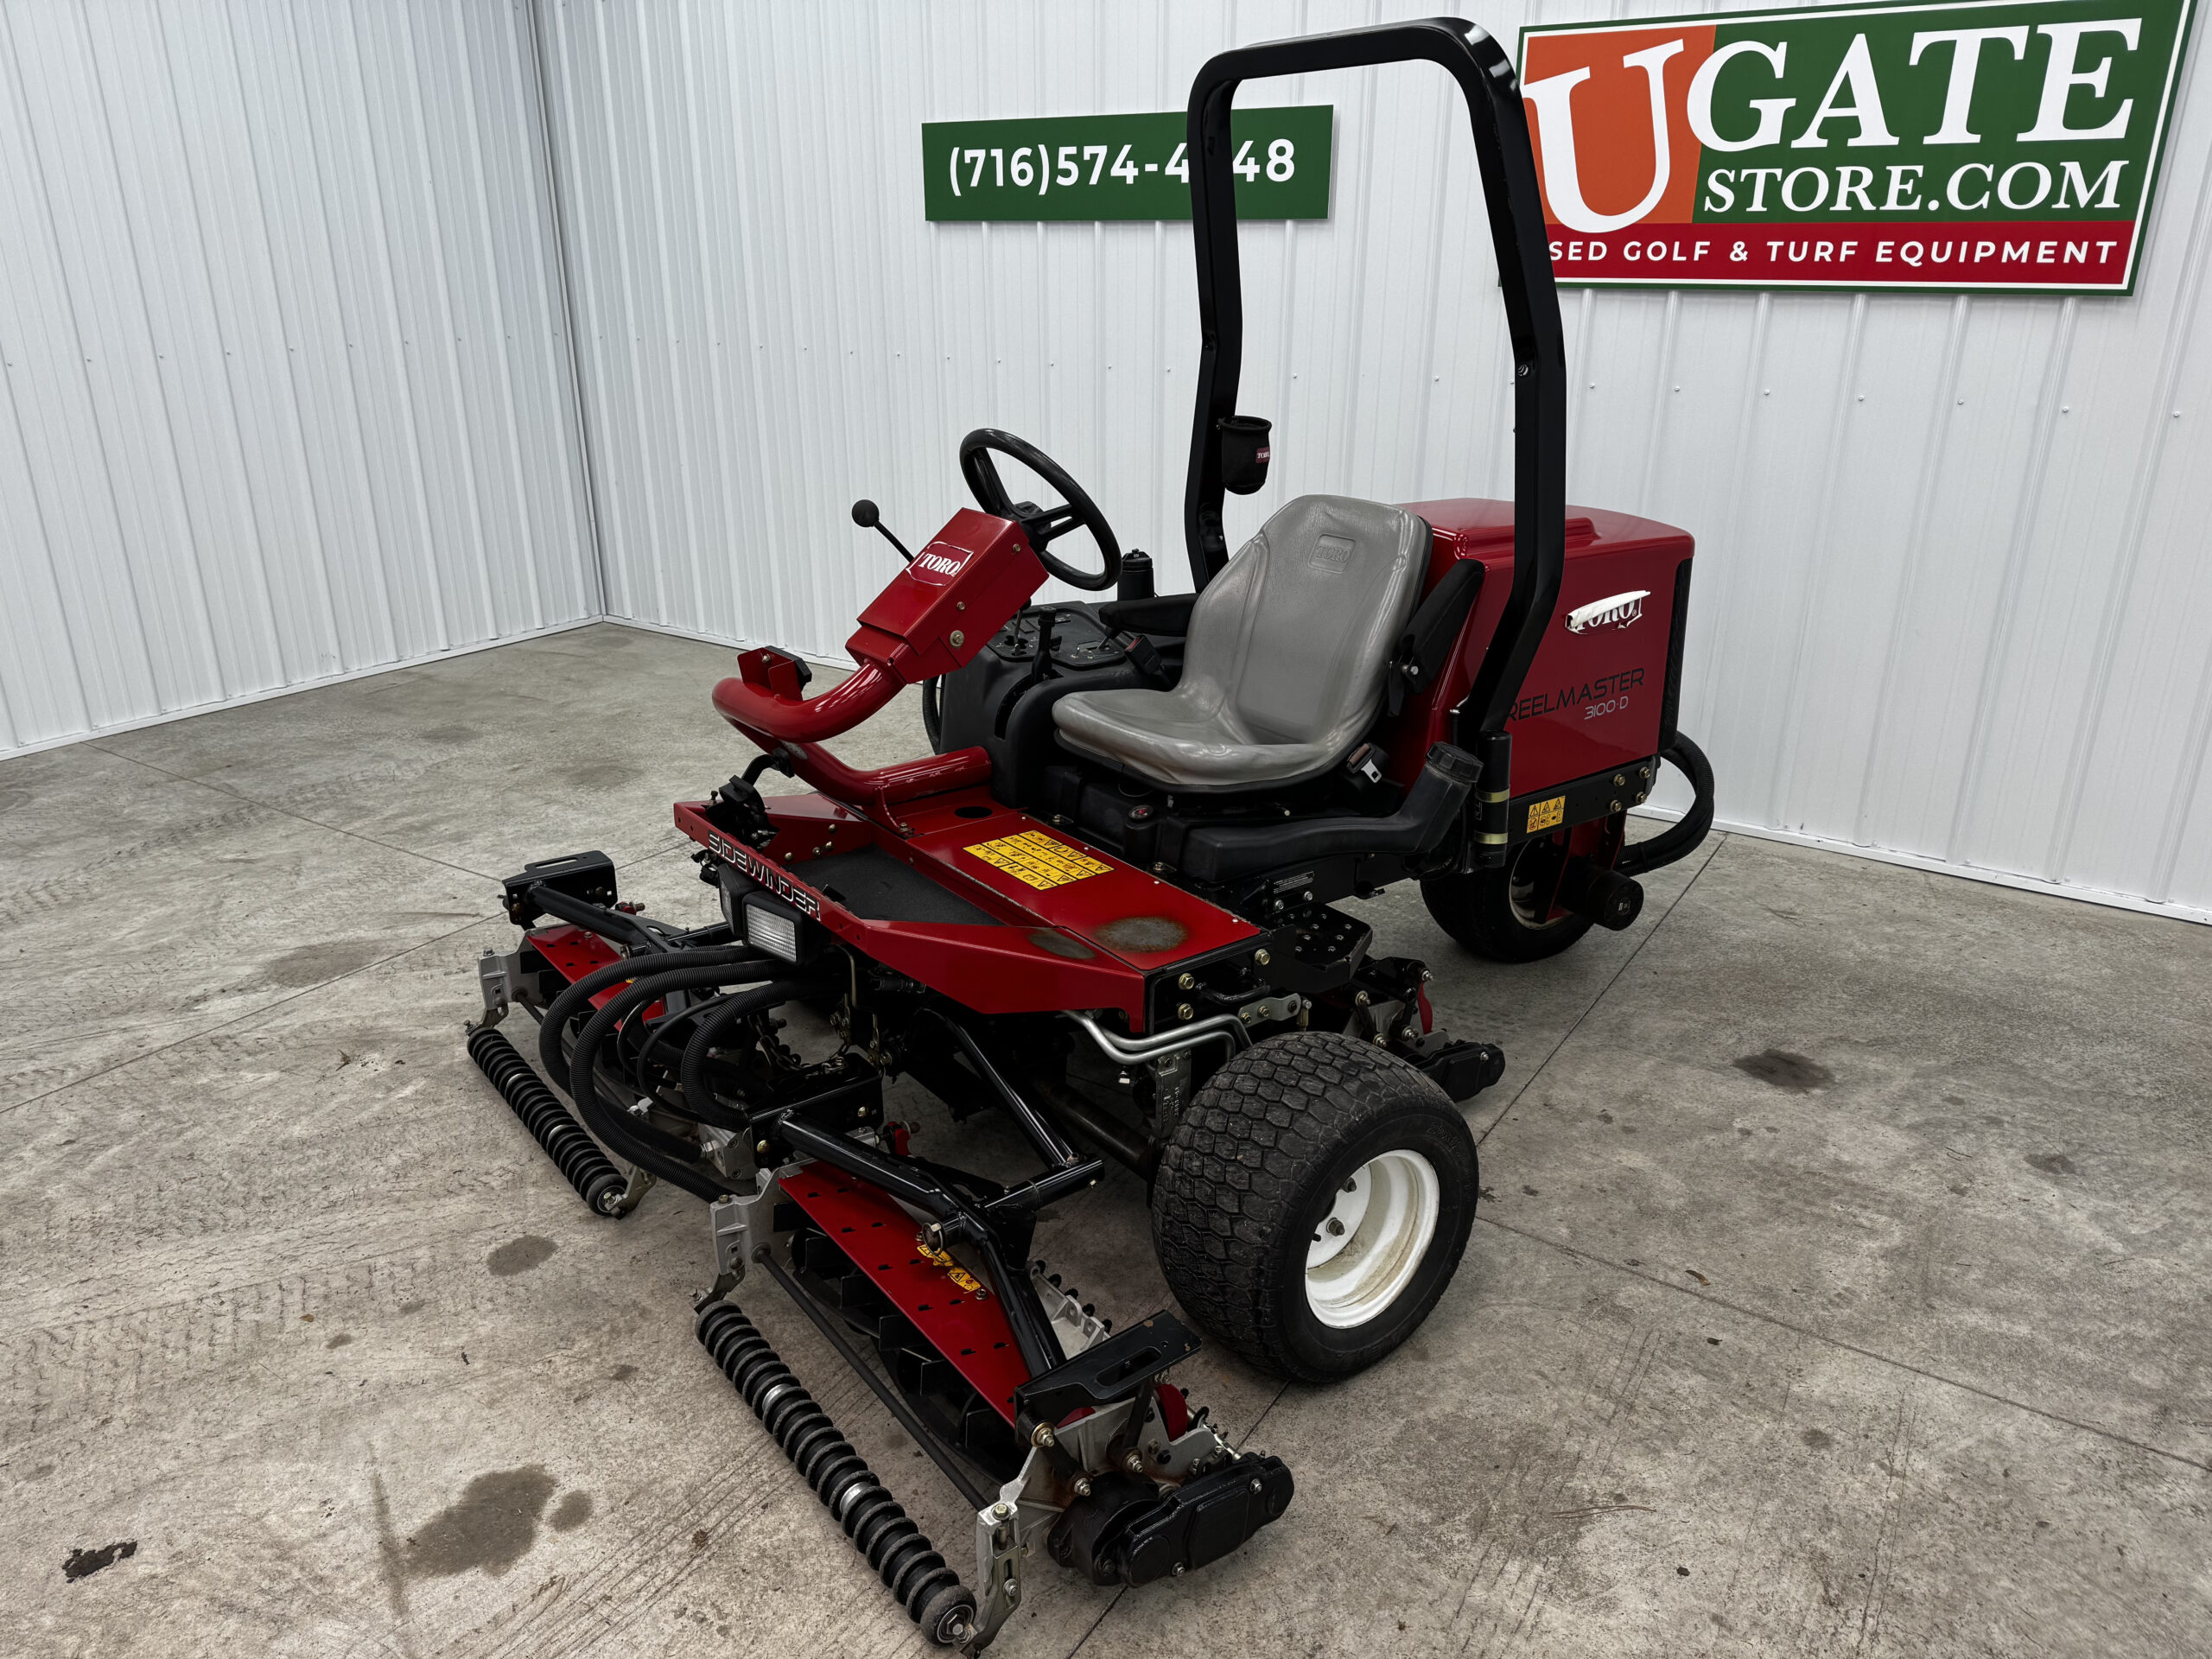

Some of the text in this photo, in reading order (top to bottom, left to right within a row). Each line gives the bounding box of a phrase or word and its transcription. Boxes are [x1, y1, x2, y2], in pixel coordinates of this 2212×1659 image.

[950, 138, 1295, 197] (716)574-448
[1704, 160, 2130, 213] STORE.COM
[1548, 240, 2119, 267] SED GOLF & TURF EQUIPMENT
[918, 553, 961, 575] TORO
[1509, 667, 1645, 722] REELMASTER
[708, 830, 822, 922] SIDEWINDER
